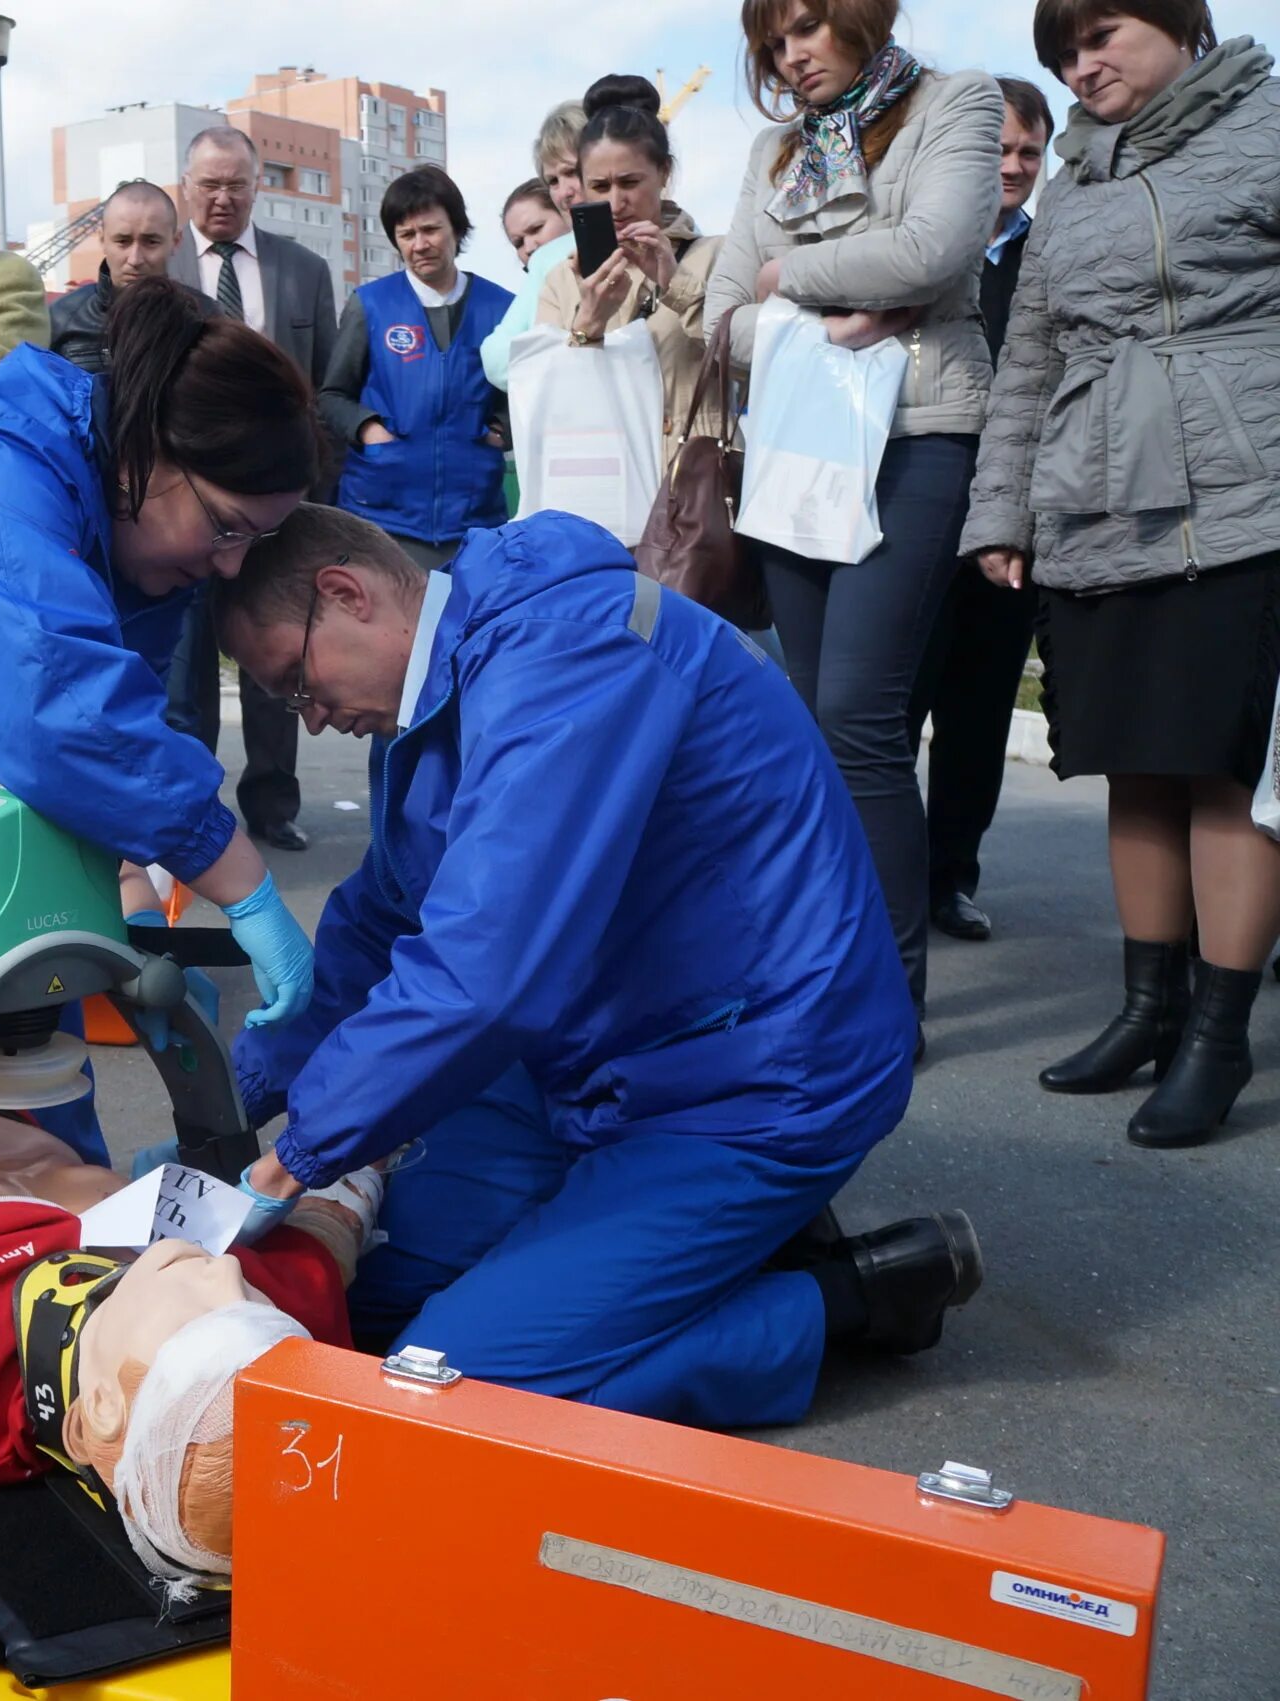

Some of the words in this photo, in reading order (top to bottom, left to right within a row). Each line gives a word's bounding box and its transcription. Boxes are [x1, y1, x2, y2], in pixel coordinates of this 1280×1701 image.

[27, 911, 68, 930] LUCAS
[34, 1383, 56, 1421] 43
[280, 1424, 344, 1501] 31
